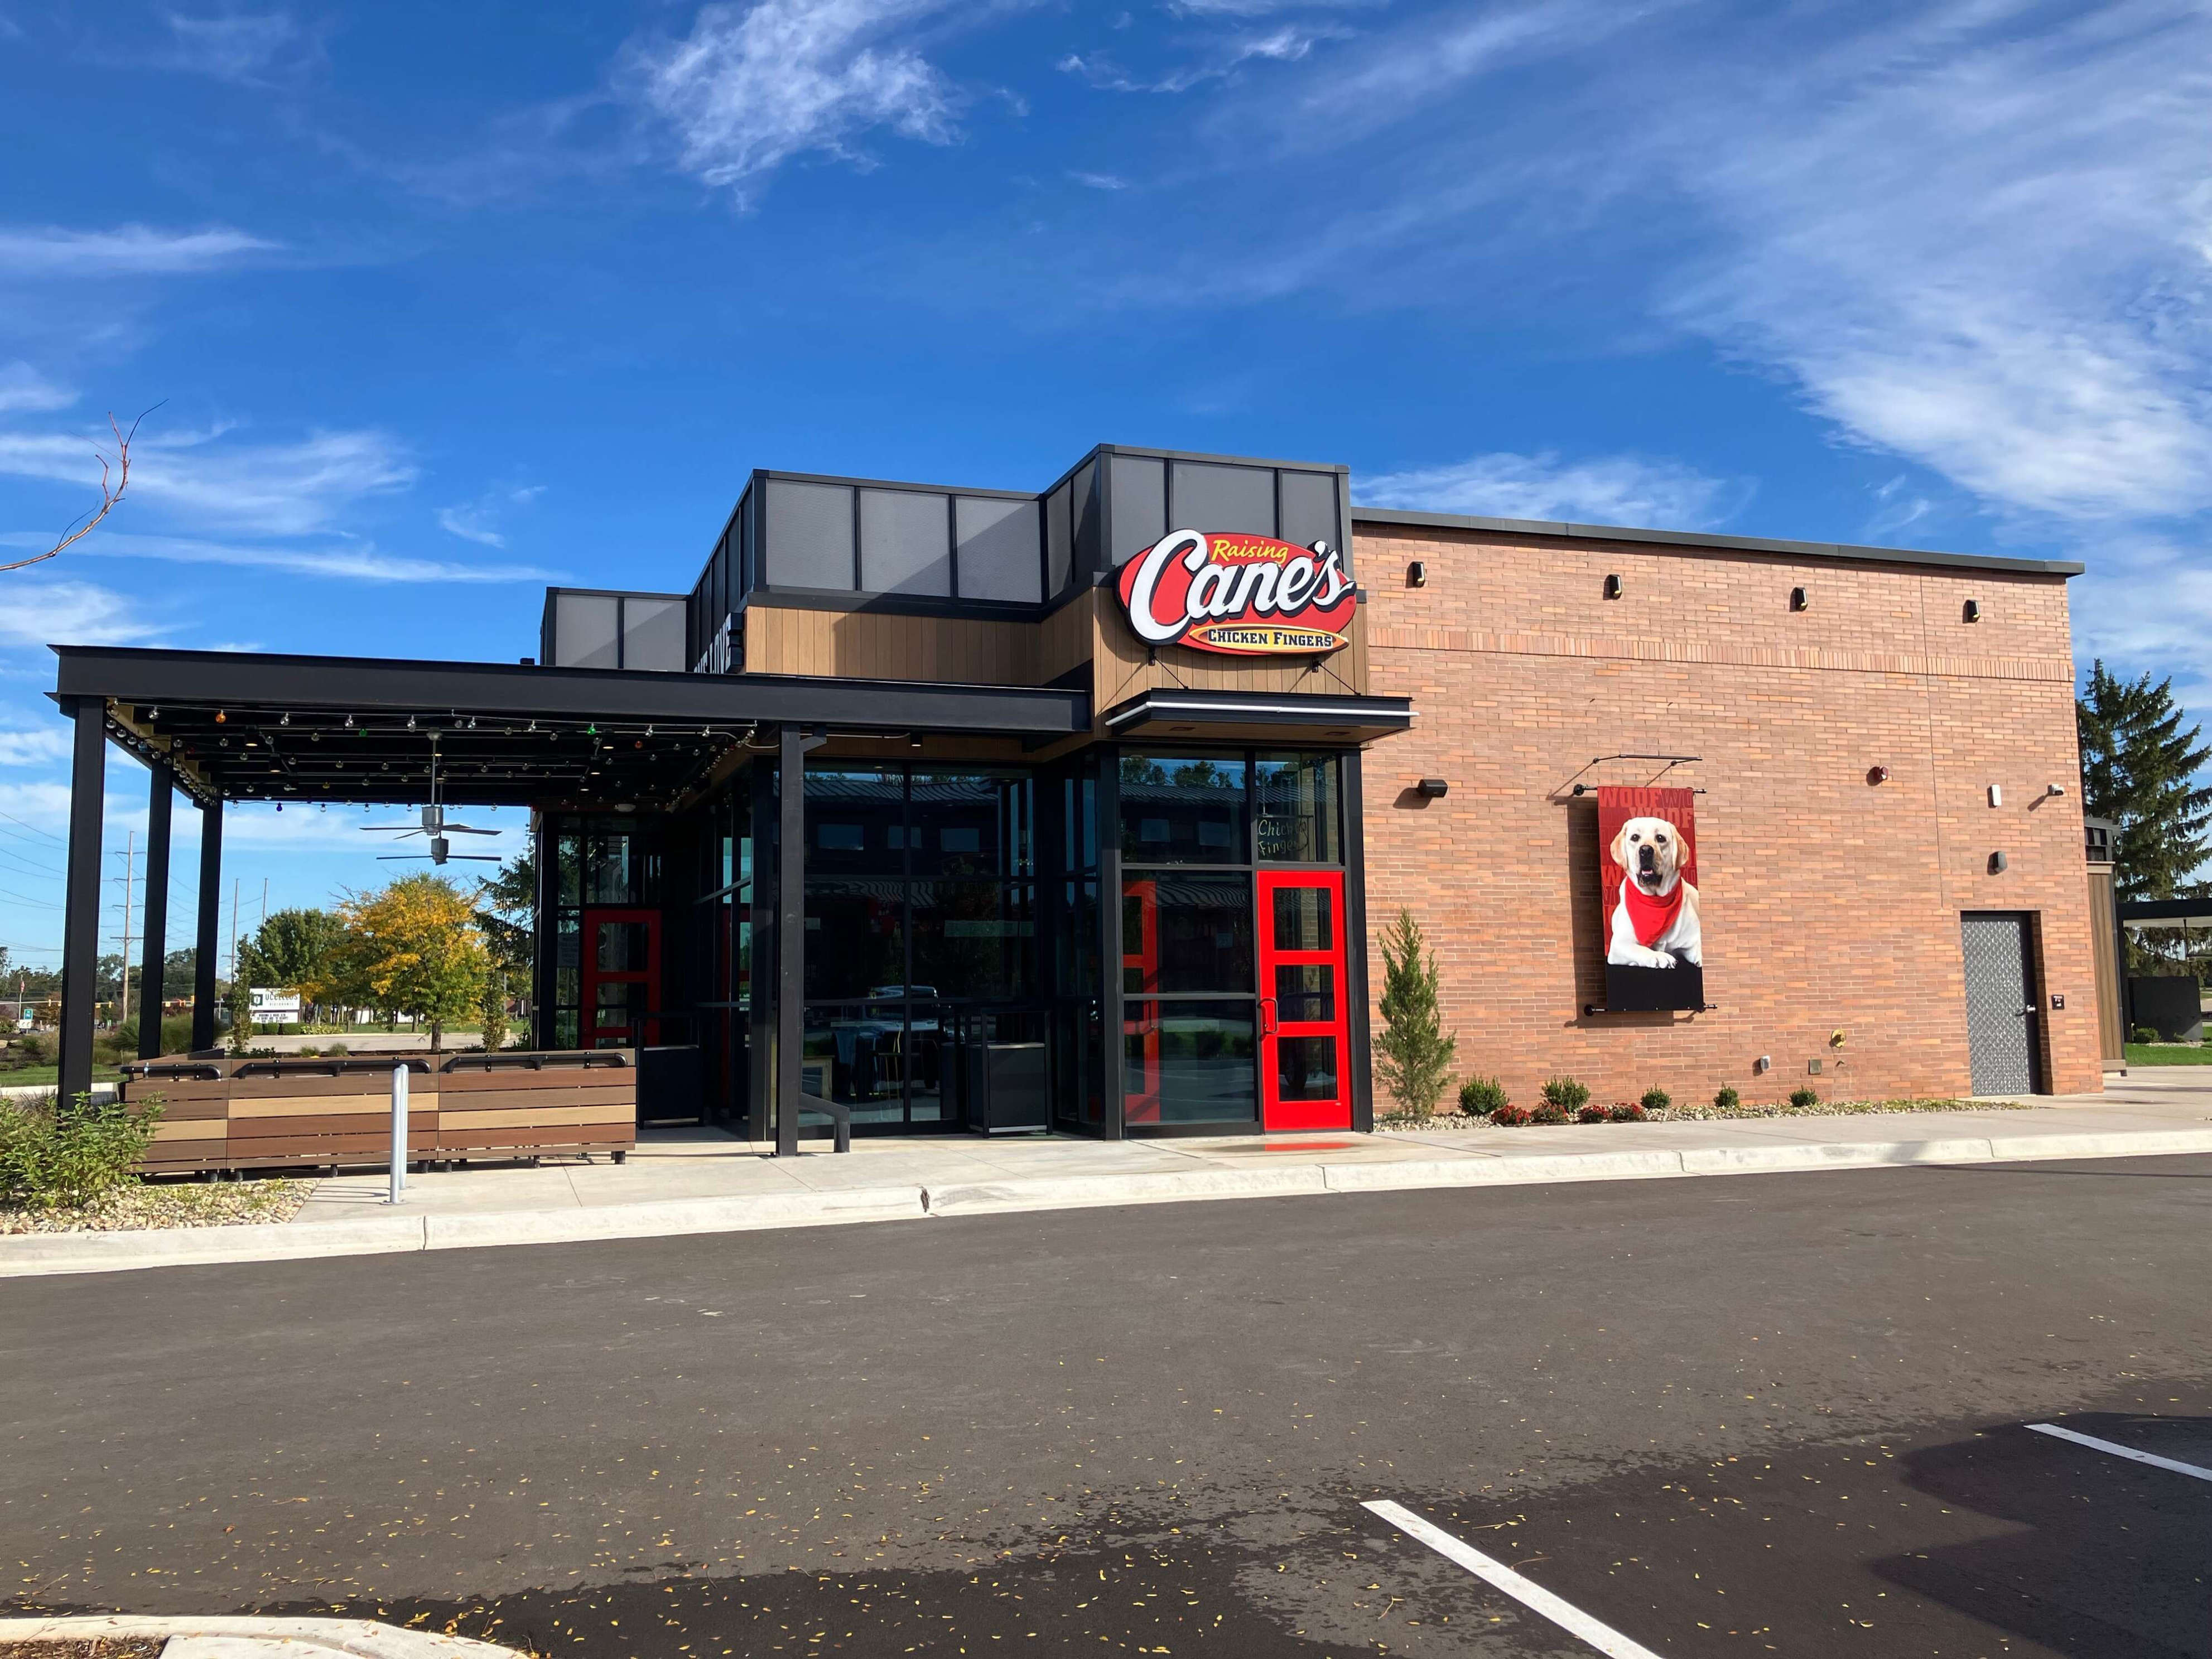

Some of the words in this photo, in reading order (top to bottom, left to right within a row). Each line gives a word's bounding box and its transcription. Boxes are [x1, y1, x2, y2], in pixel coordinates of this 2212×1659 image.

[1211, 539, 1288, 564] Raising
[1129, 528, 1358, 642] Cane's
[1208, 628, 1268, 644] CHICKEN
[1273, 631, 1333, 648] FINGERS
[1598, 787, 1660, 808] WOOF
